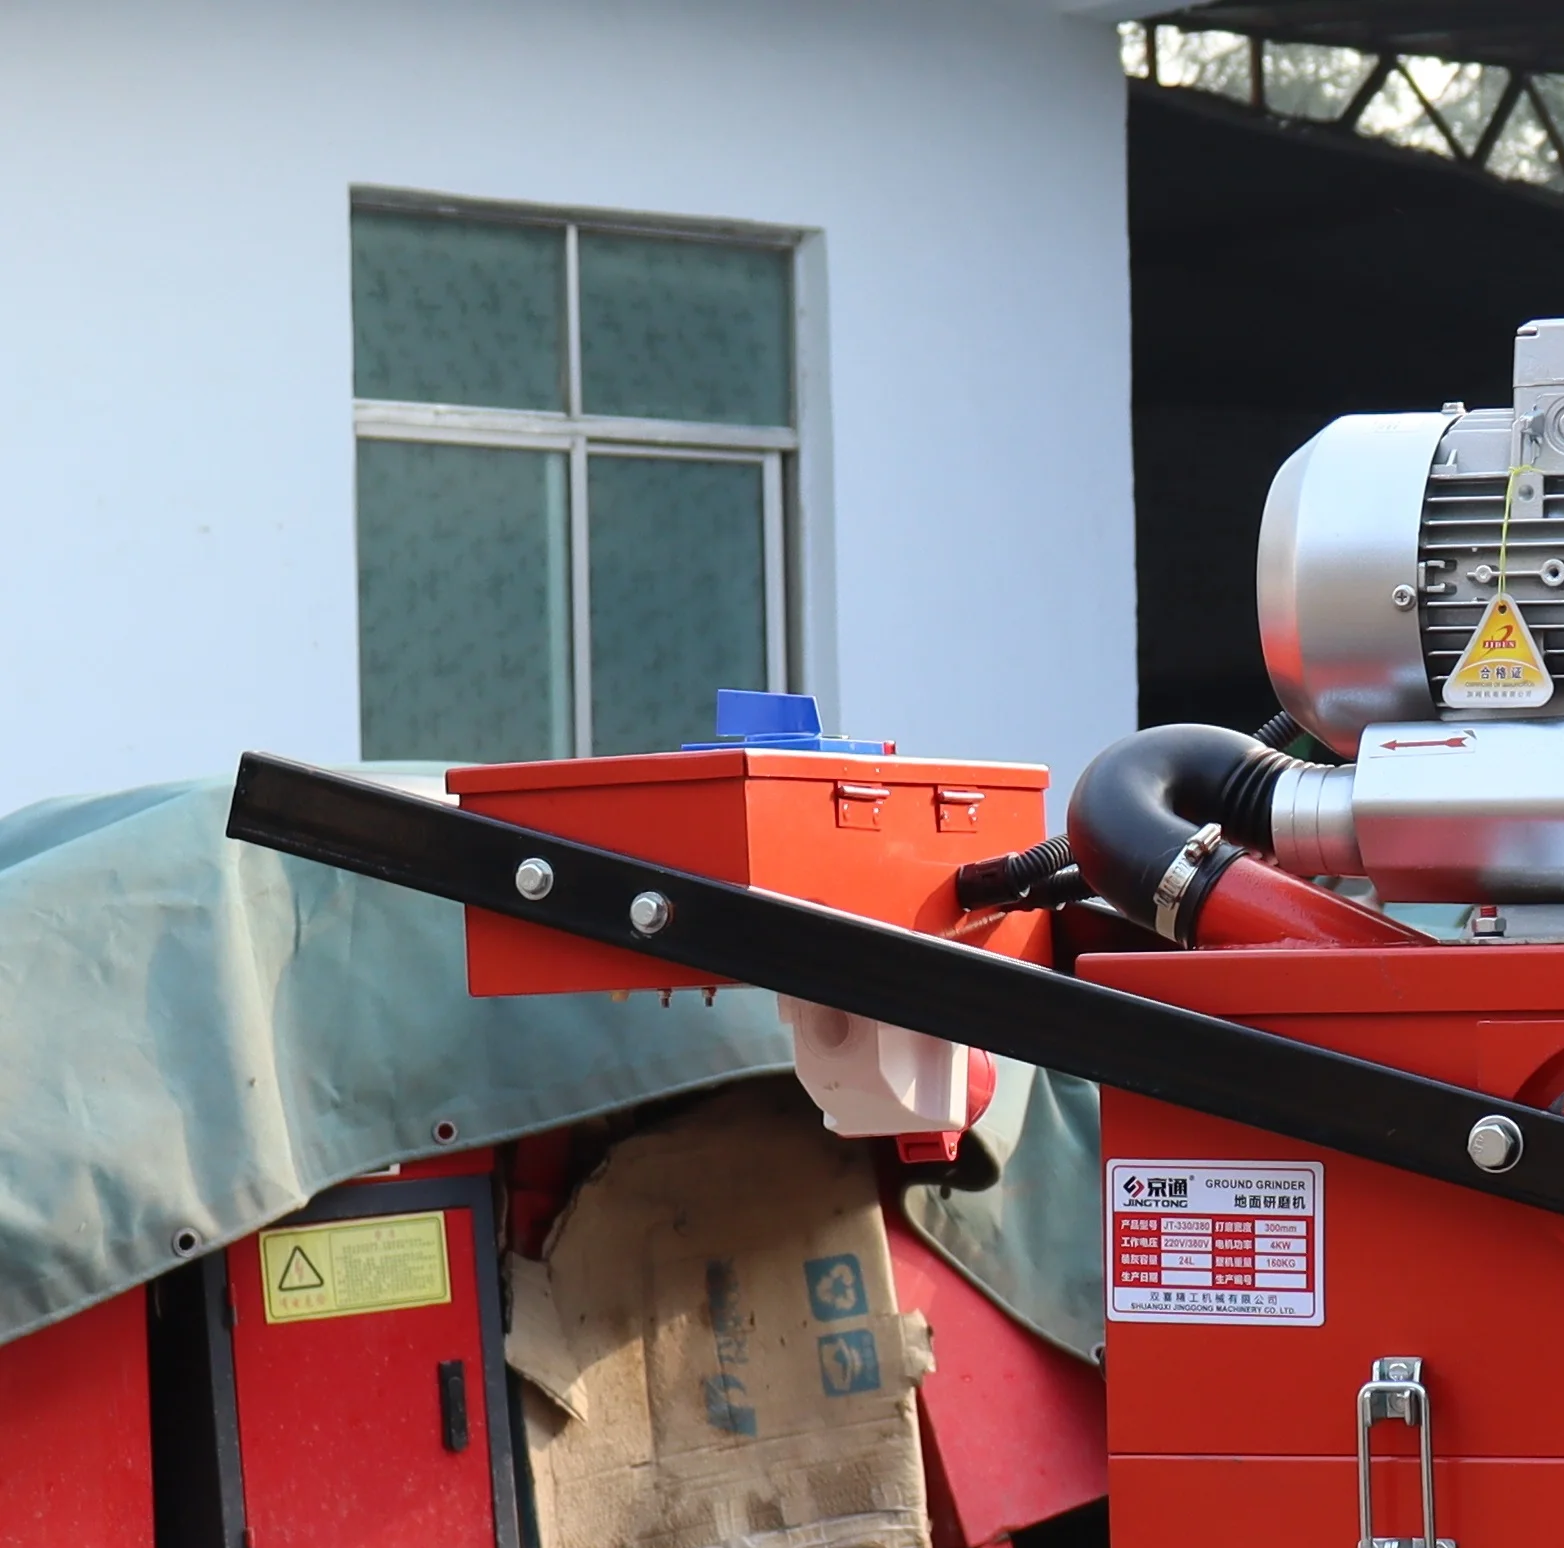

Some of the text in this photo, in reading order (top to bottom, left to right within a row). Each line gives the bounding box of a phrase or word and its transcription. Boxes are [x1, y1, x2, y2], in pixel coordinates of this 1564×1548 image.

[1480, 666, 1522, 679] 合格证
[1147, 1178, 1187, 1197] 京通
[1205, 1179, 1305, 1190] GROUND GRINDER
[1123, 1199, 1187, 1208] JINGTONG
[1234, 1194, 1306, 1209] 地面研磨机
[1164, 1221, 1210, 1231] JT-330/380
[1264, 1223, 1297, 1232] 300mm
[1121, 1236, 1158, 1248] 工作电压
[1164, 1239, 1209, 1248] 220V/380V
[1270, 1241, 1291, 1249] 4KW
[1178, 1256, 1195, 1265] 24L
[1131, 1303, 1171, 1311] SHUANGXI
[1216, 1305, 1261, 1313] MACHINERY
